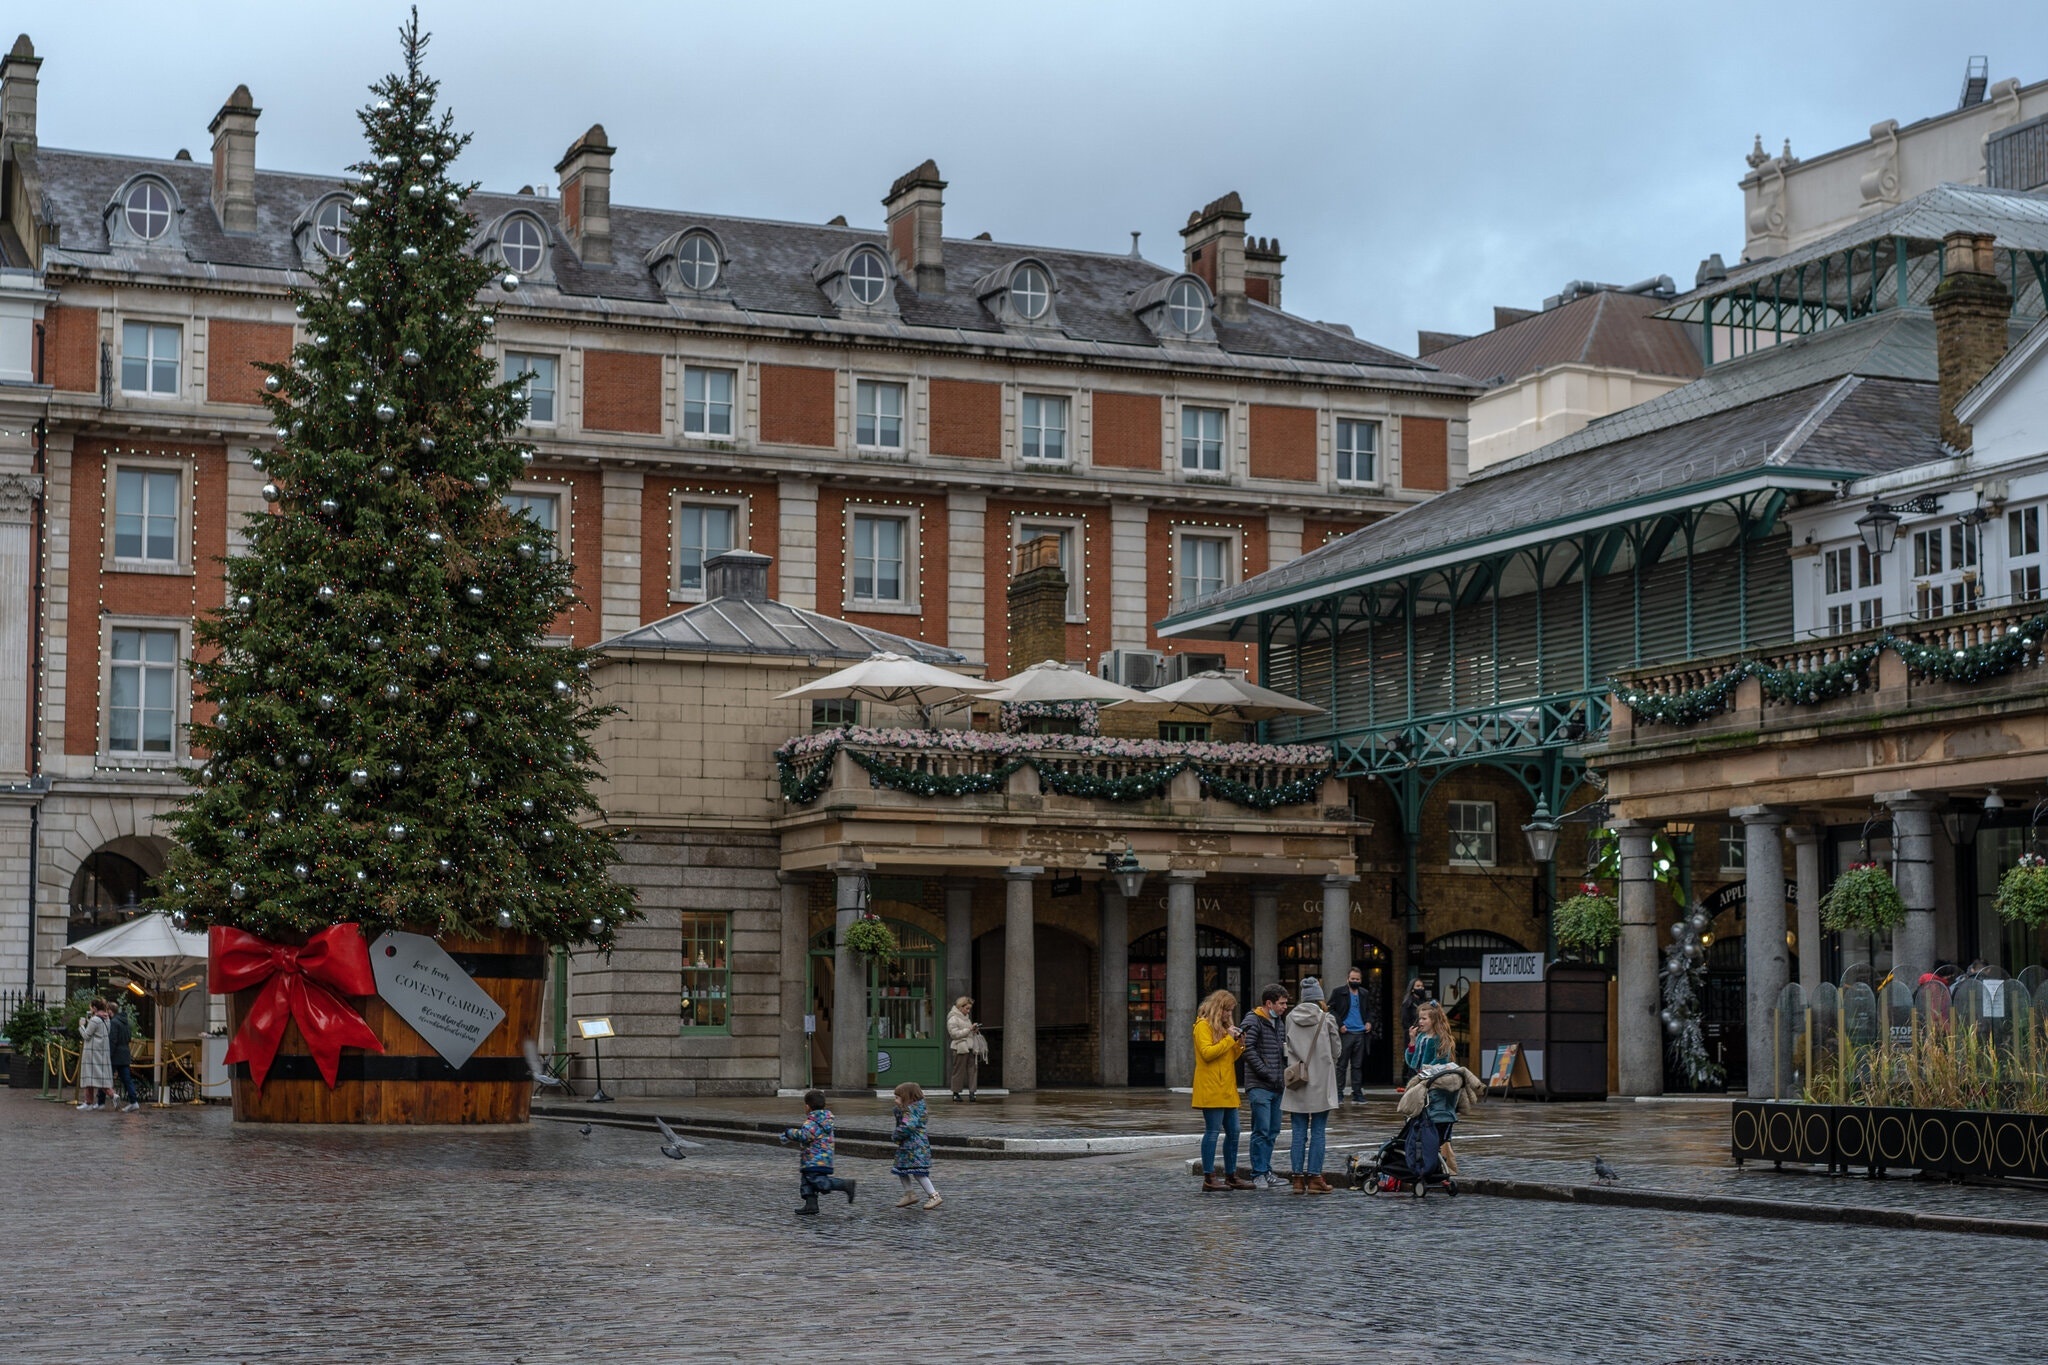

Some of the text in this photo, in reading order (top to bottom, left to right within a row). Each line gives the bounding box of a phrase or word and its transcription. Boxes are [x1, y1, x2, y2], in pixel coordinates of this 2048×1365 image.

[1159, 897, 1221, 911] GIVA
[1489, 956, 1536, 975] BEACH HOUSE
[395, 974, 497, 1021] COVENT GARDEN
